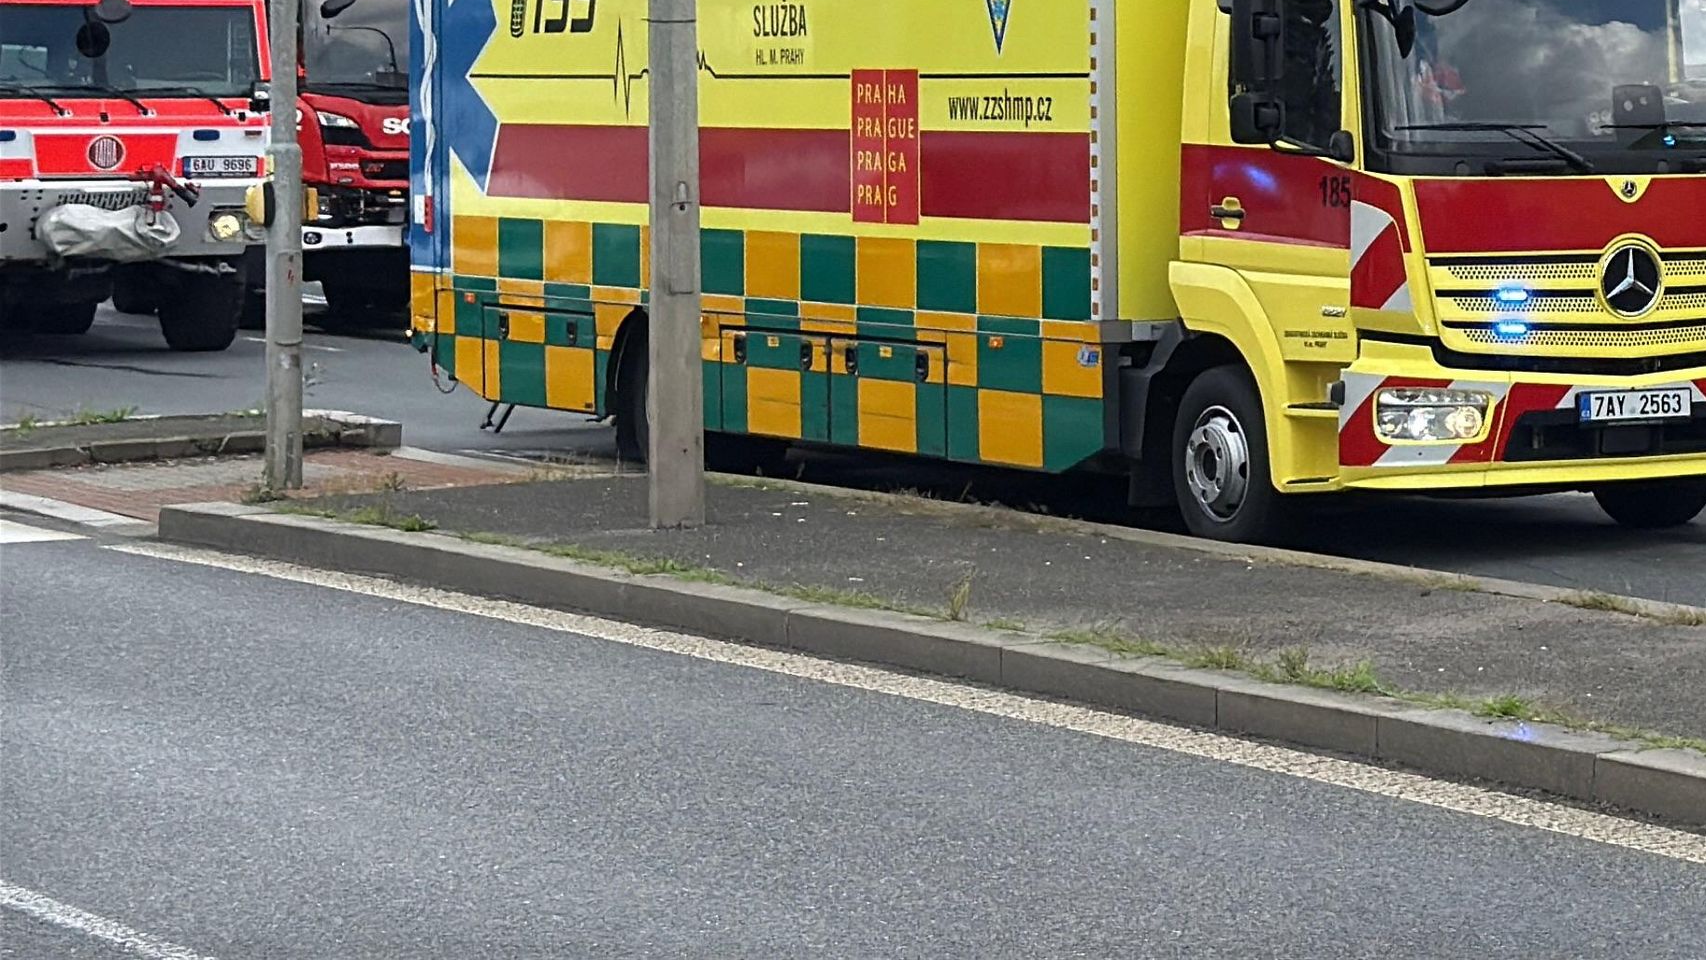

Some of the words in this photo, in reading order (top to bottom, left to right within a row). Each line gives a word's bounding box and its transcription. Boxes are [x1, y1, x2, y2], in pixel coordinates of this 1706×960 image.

[755, 49, 767, 66] HL.
[769, 49, 778, 66] M.
[780, 48, 805, 66] PRAHY
[947, 88, 1053, 128] www.zzshmp.cz
[1319, 175, 1352, 208] 185
[1594, 395, 1626, 417] 7AY
[1639, 393, 1682, 415] 2563
